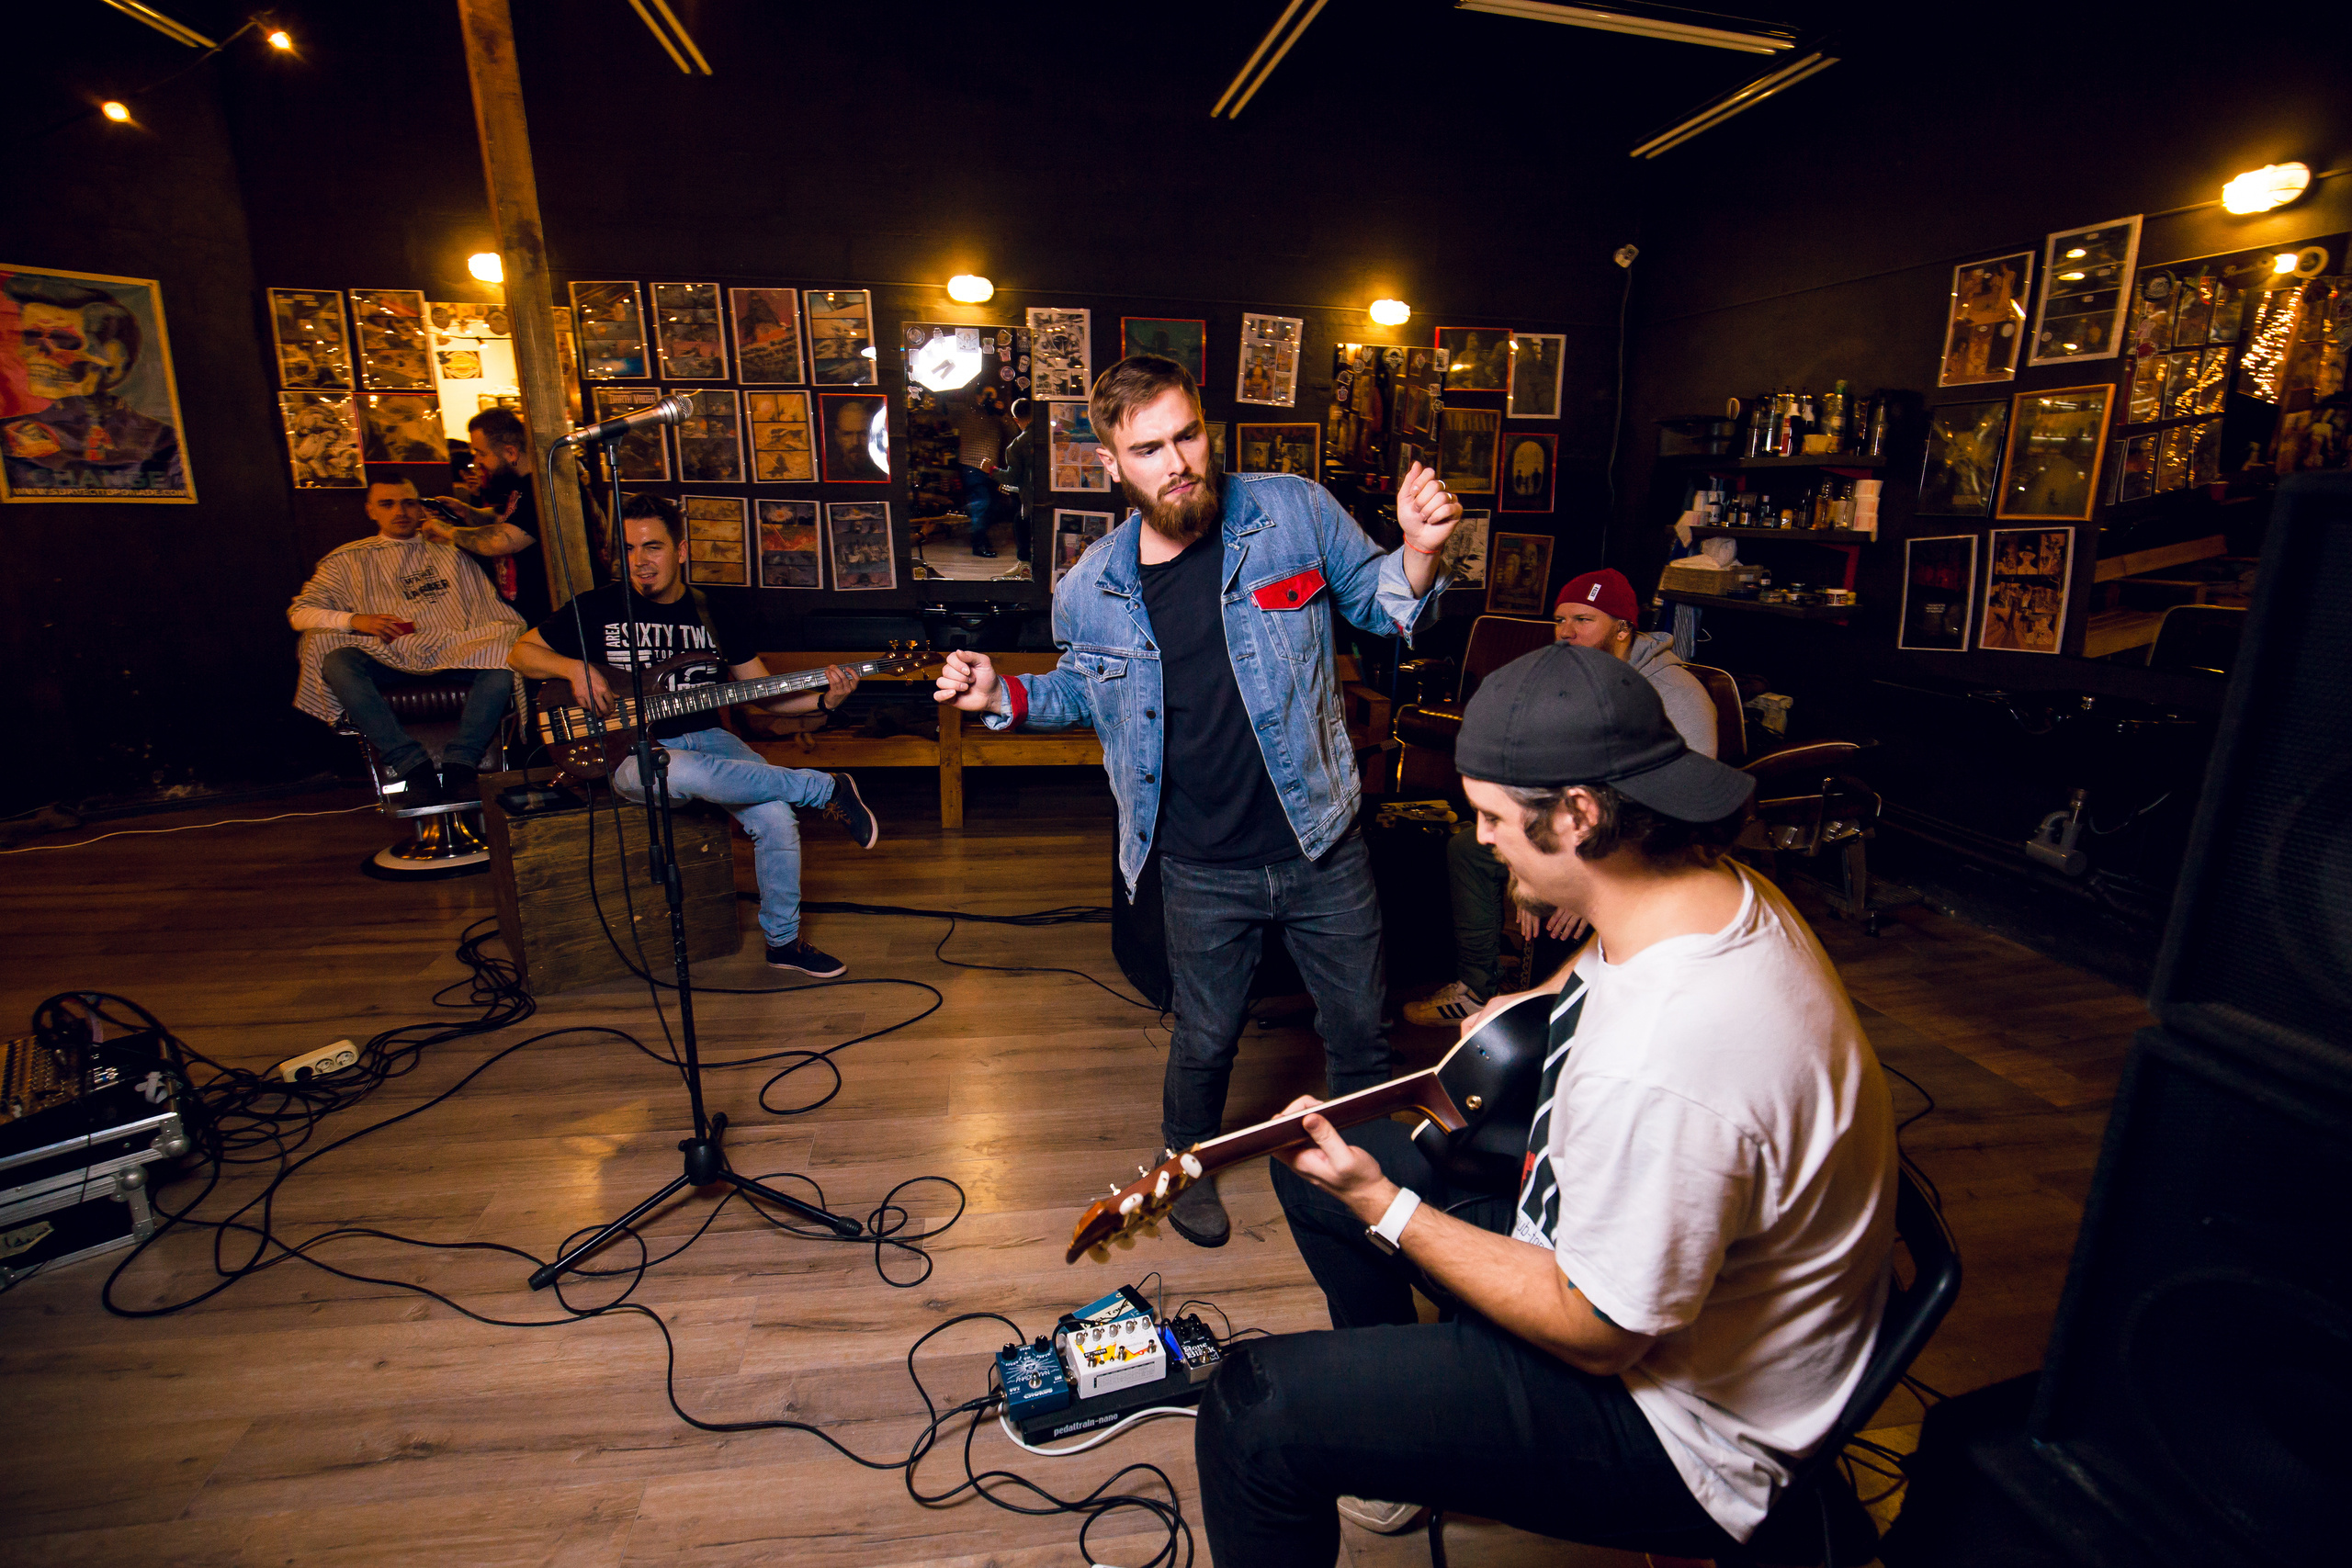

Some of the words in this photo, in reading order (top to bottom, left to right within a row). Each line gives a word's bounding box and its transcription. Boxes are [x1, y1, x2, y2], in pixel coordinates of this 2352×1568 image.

[609, 394, 632, 403] DARTH
[633, 394, 657, 404] VADER
[605, 623, 621, 649] AREA
[621, 622, 673, 648] SIXTY
[1023, 1387, 1054, 1400] CHORUS
[1053, 1413, 1119, 1438] pedaltrain-nano
